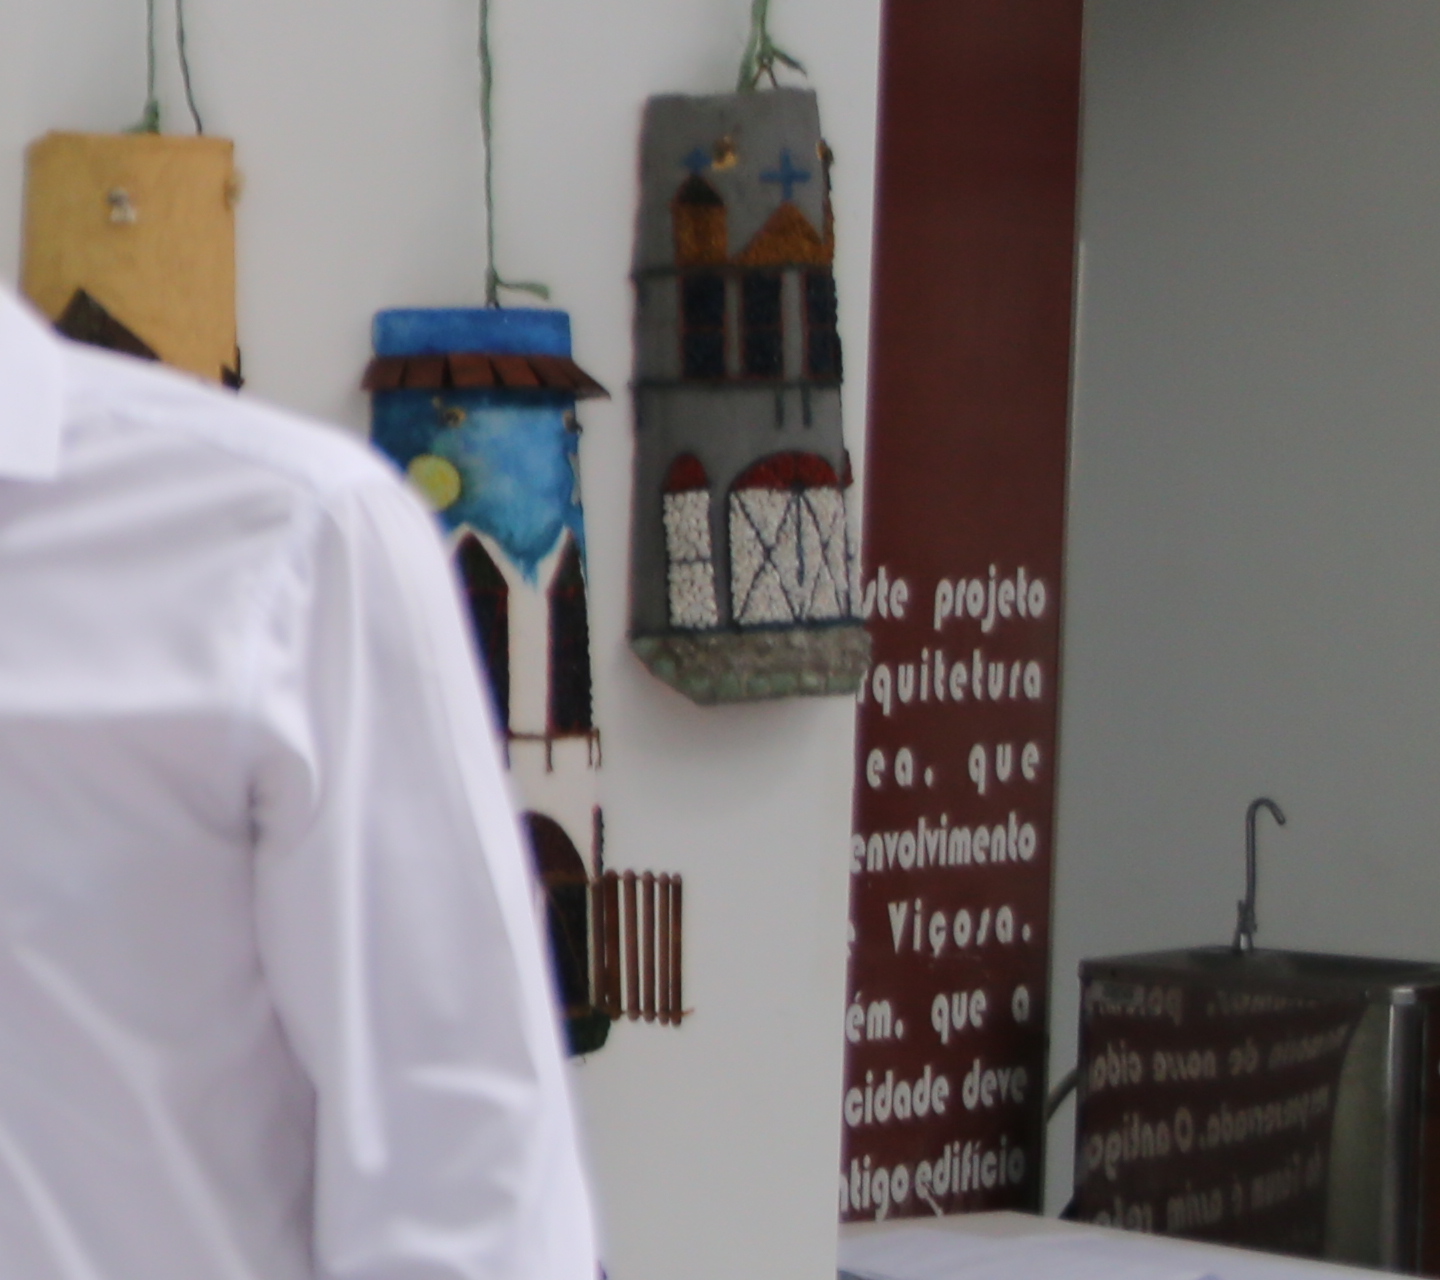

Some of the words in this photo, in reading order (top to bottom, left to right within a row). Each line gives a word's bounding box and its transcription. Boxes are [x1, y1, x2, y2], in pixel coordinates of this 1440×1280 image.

[934, 562, 1046, 633] projeto
[968, 740, 1042, 796] que
[850, 810, 1037, 874] envolvimento
[886, 896, 1032, 959] Viçosa.
[931, 987, 987, 1046] que
[1011, 983, 1030, 1024] a
[844, 1061, 950, 1128] cidade
[961, 1056, 1028, 1111] deve
[915, 1133, 1026, 1200] edifício
